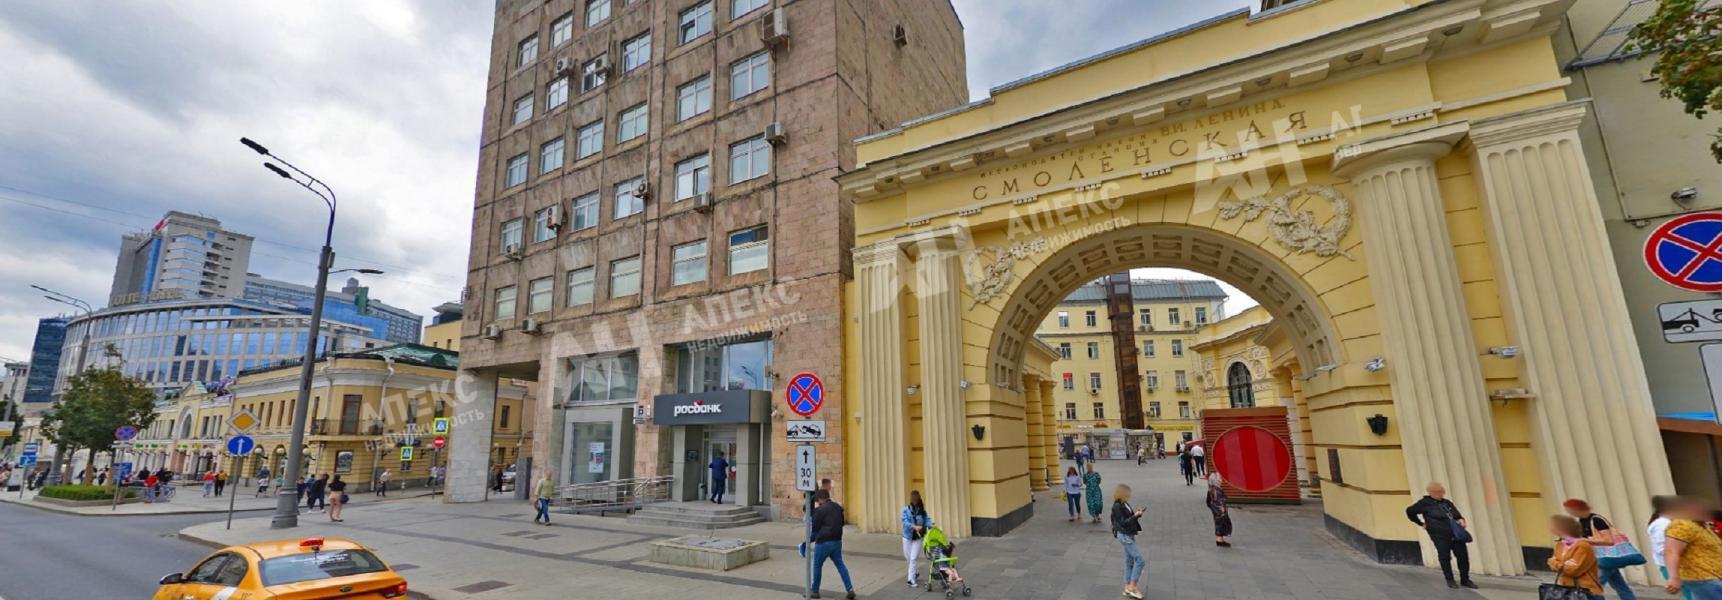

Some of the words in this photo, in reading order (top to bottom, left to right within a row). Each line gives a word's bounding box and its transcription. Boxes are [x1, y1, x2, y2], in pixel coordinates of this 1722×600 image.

[1194, 99, 1285, 129] ЛЕНИНА
[972, 110, 1308, 201] СМОЛЕНСКАЯ
[673, 399, 722, 417] росбанк
[800, 467, 811, 478] 30
